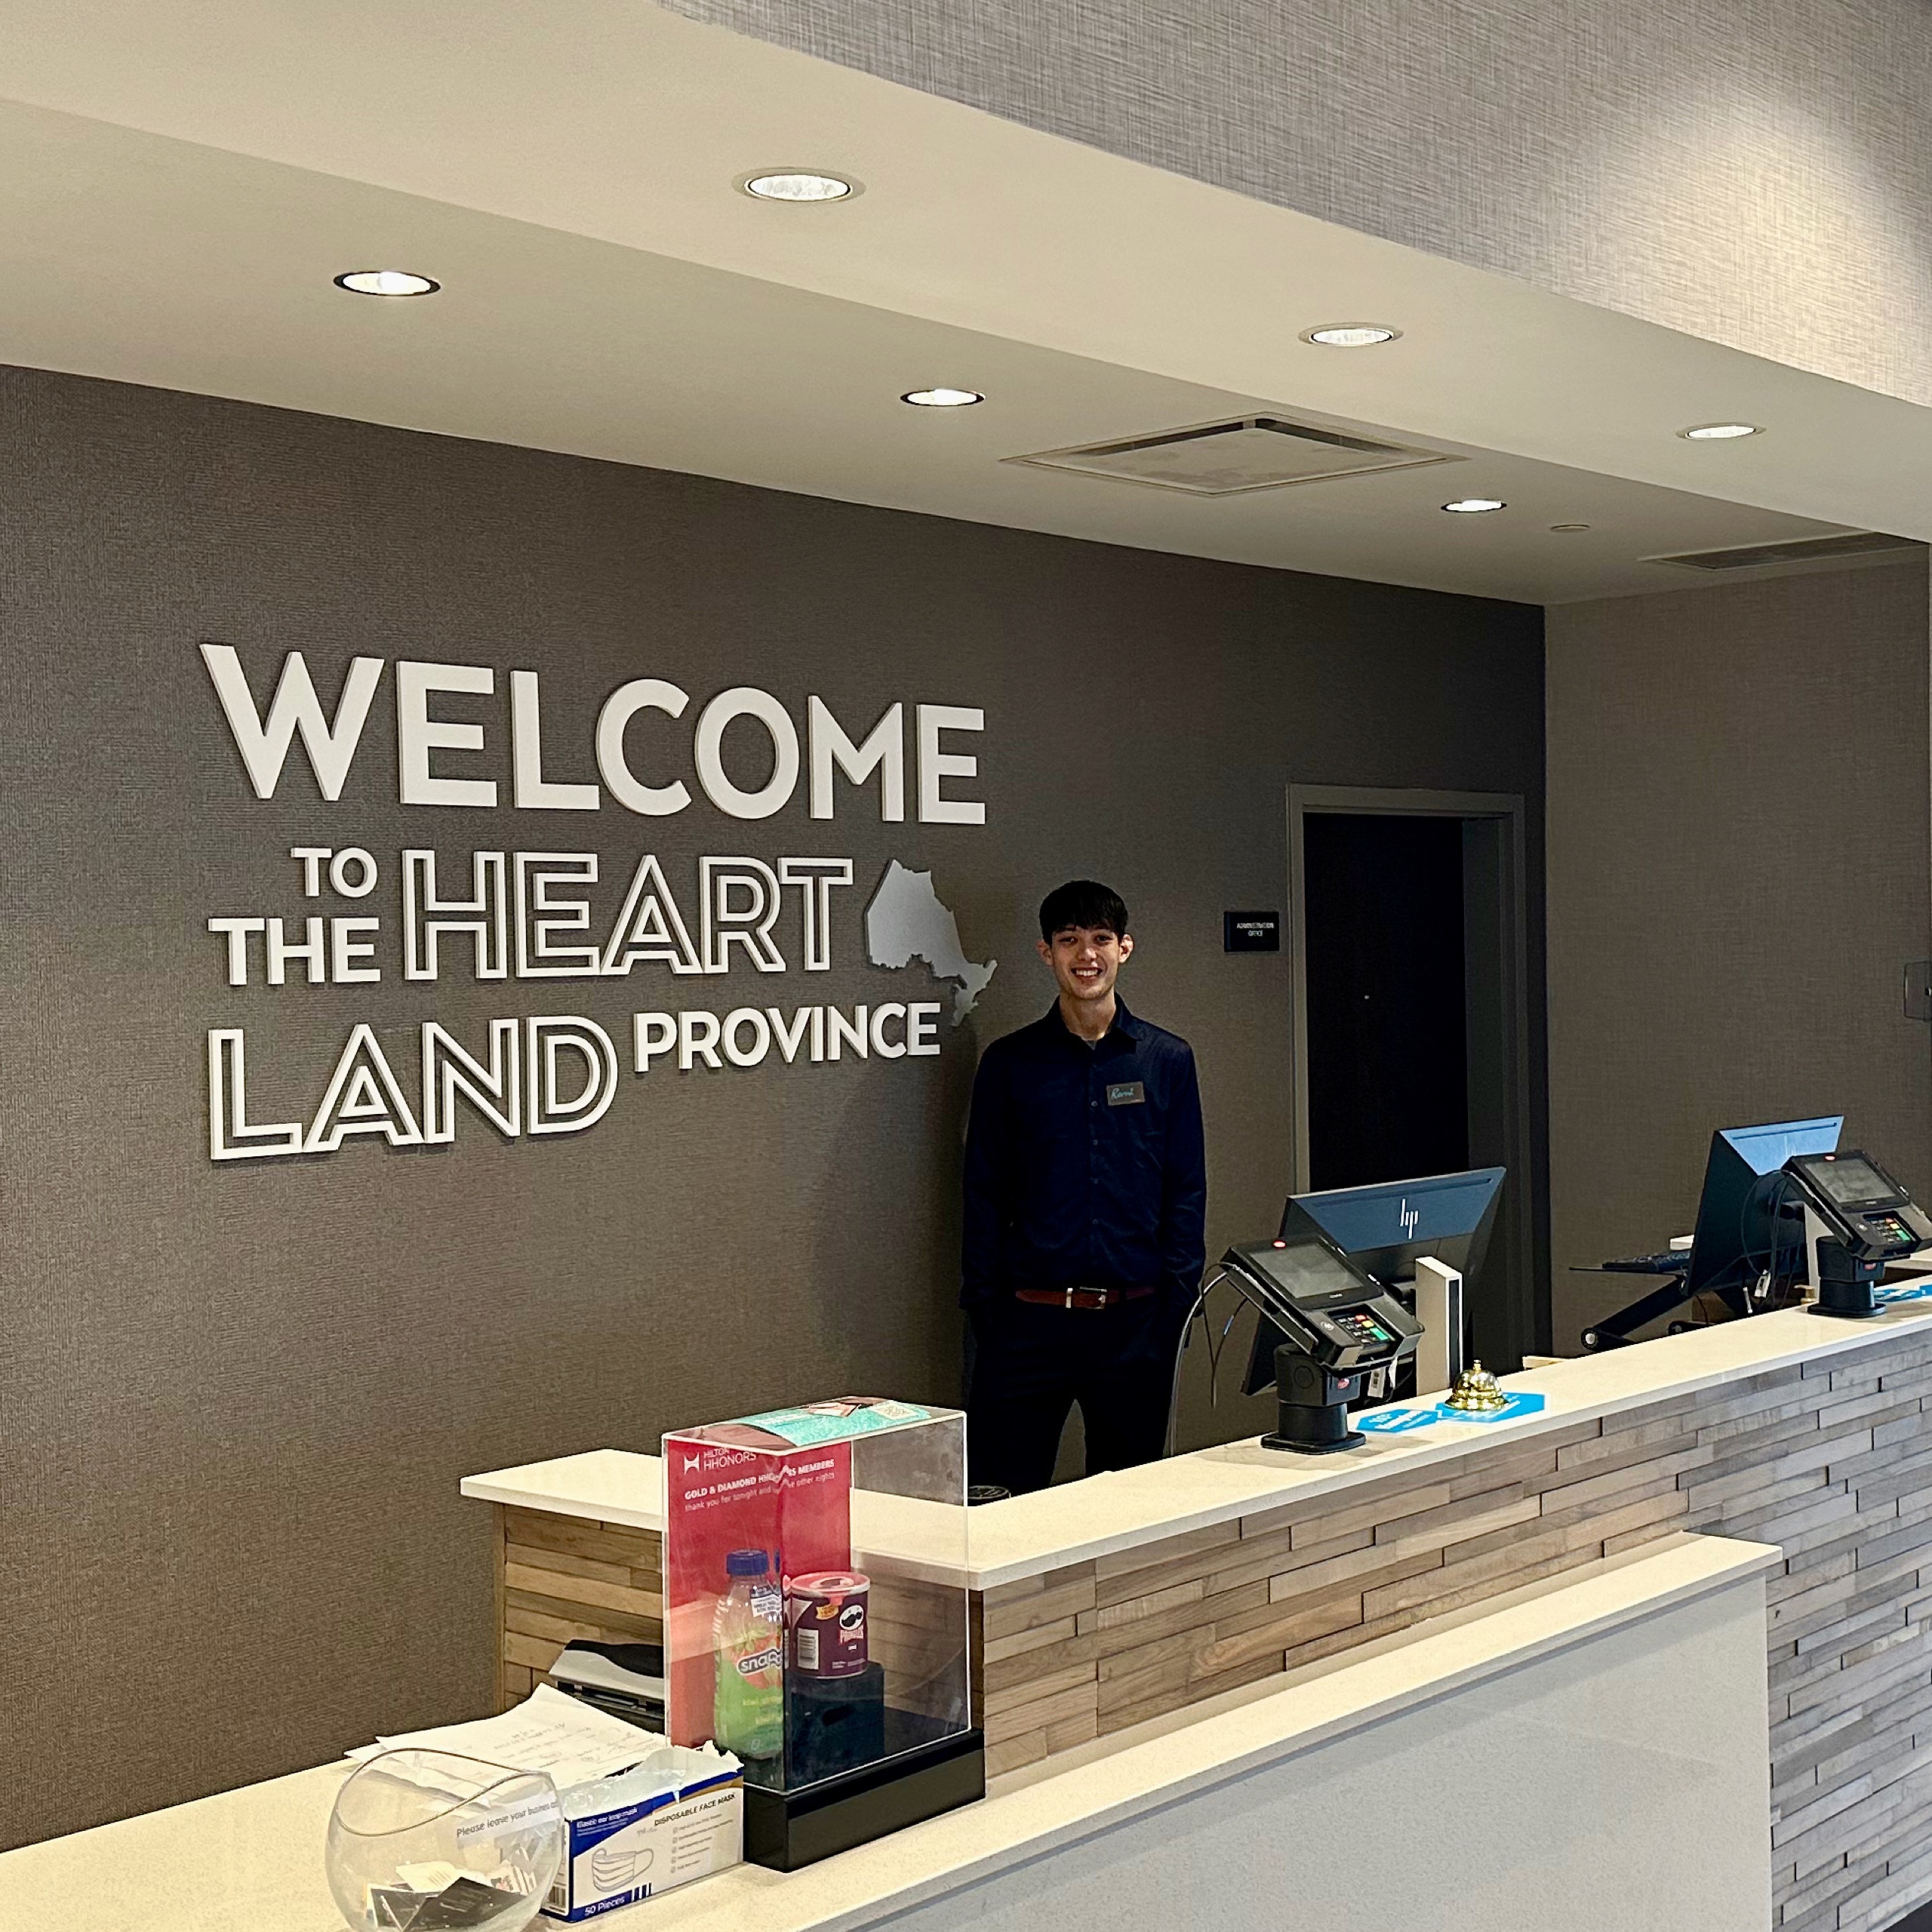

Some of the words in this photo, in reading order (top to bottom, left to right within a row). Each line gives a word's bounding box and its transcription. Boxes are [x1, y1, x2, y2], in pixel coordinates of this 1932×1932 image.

[199, 643, 986, 824] WELCOME
[291, 846, 377, 897] TO
[402, 848, 854, 980] HEART
[208, 917, 381, 986] THE
[208, 1015, 618, 1161] LAND
[633, 1002, 941, 1072] PROVINCE
[1399, 1198, 1419, 1239] hp
[703, 1451, 757, 1471] HHONORS
[685, 1486, 708, 1500] GOLD
[709, 1485, 715, 1495] &
[718, 1476, 757, 1493] DIAMOND
[457, 1822, 485, 1838] Please
[487, 1815, 509, 1828] leave
[510, 1810, 527, 1823] your
[654, 1806, 698, 1826] DISPOSABLE
[699, 1800, 716, 1811] FACE
[717, 1794, 736, 1806] MASK
[584, 1906, 596, 1916] 50
[598, 1896, 625, 1912] Pieces
